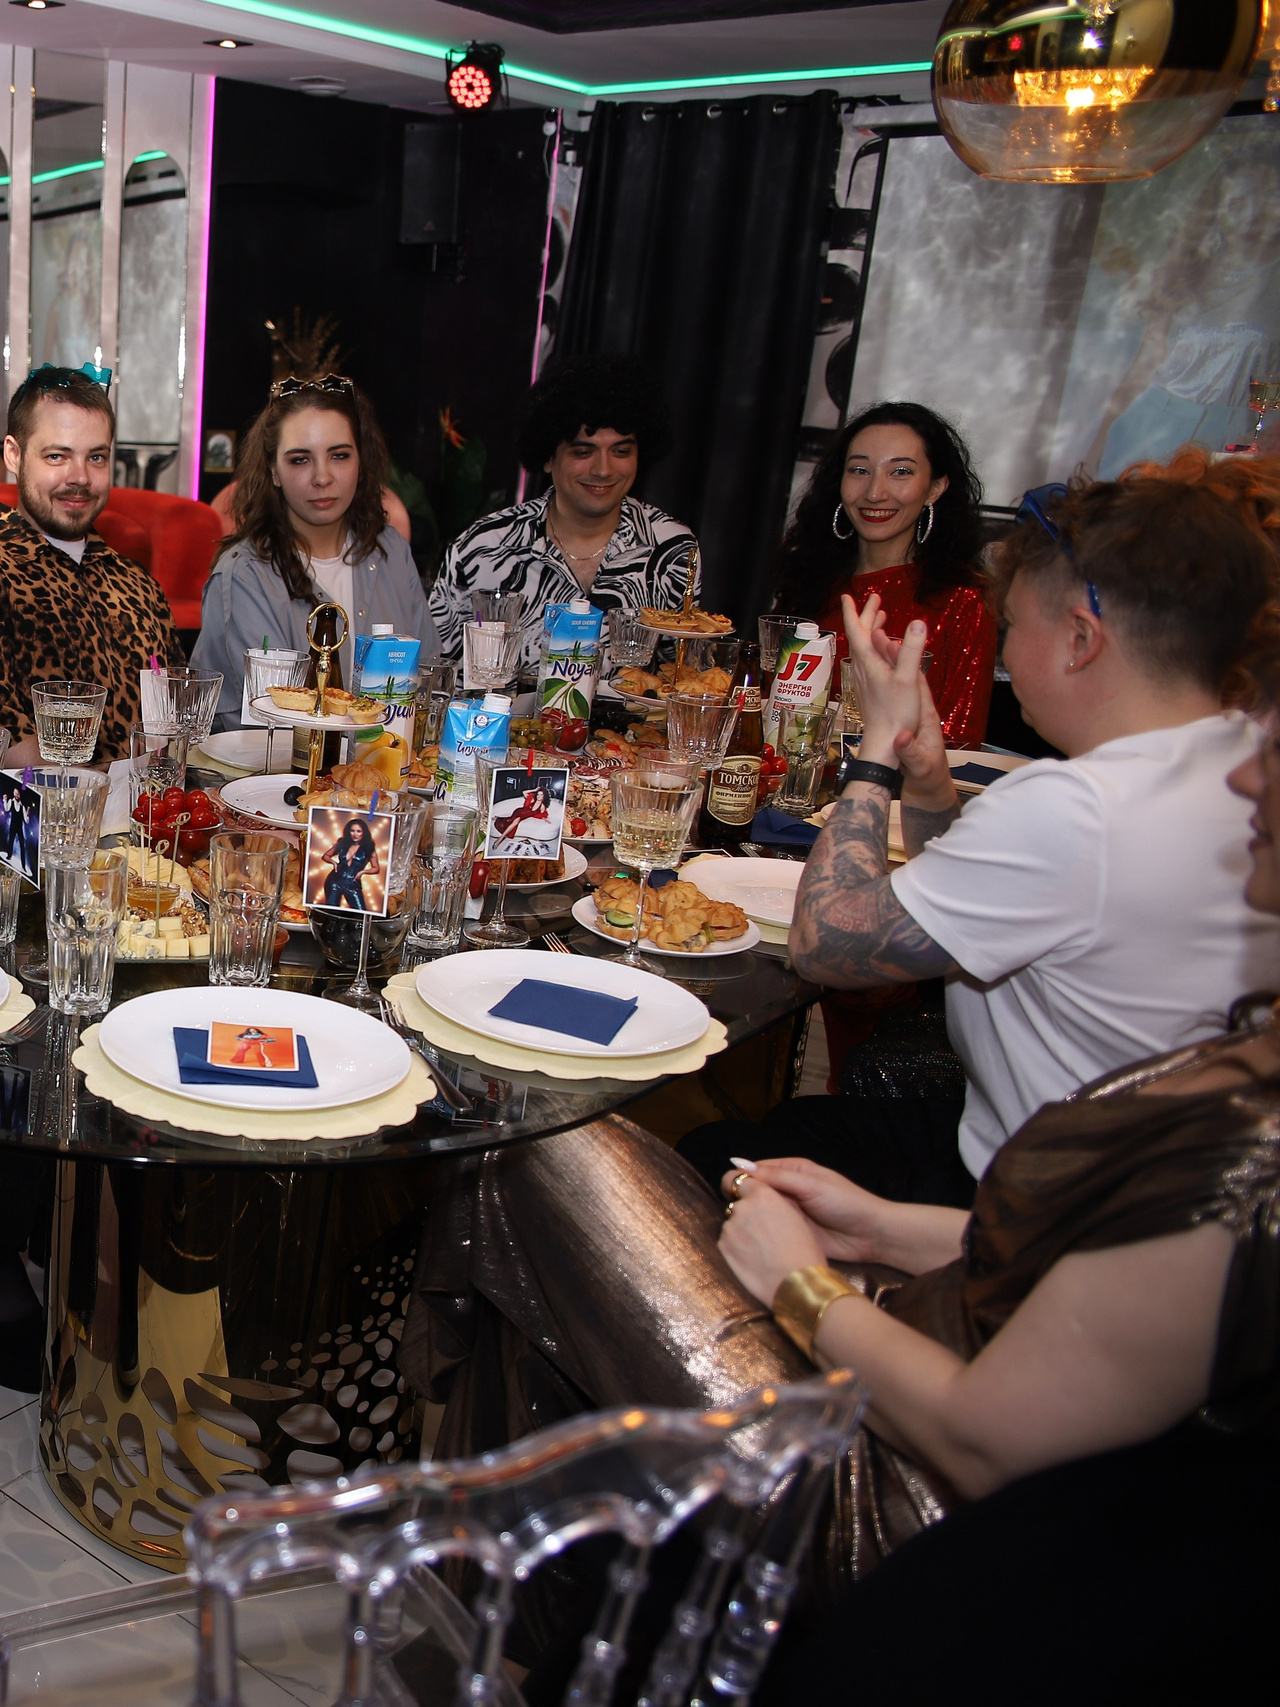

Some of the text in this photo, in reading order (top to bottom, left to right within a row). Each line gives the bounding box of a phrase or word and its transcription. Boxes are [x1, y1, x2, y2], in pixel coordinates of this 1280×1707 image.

[777, 652, 823, 681] J7
[777, 688, 811, 698] ФРУКТОВ
[778, 682, 812, 692] ЭНЕРГИЯ
[718, 772, 757, 786] ТОМСКО
